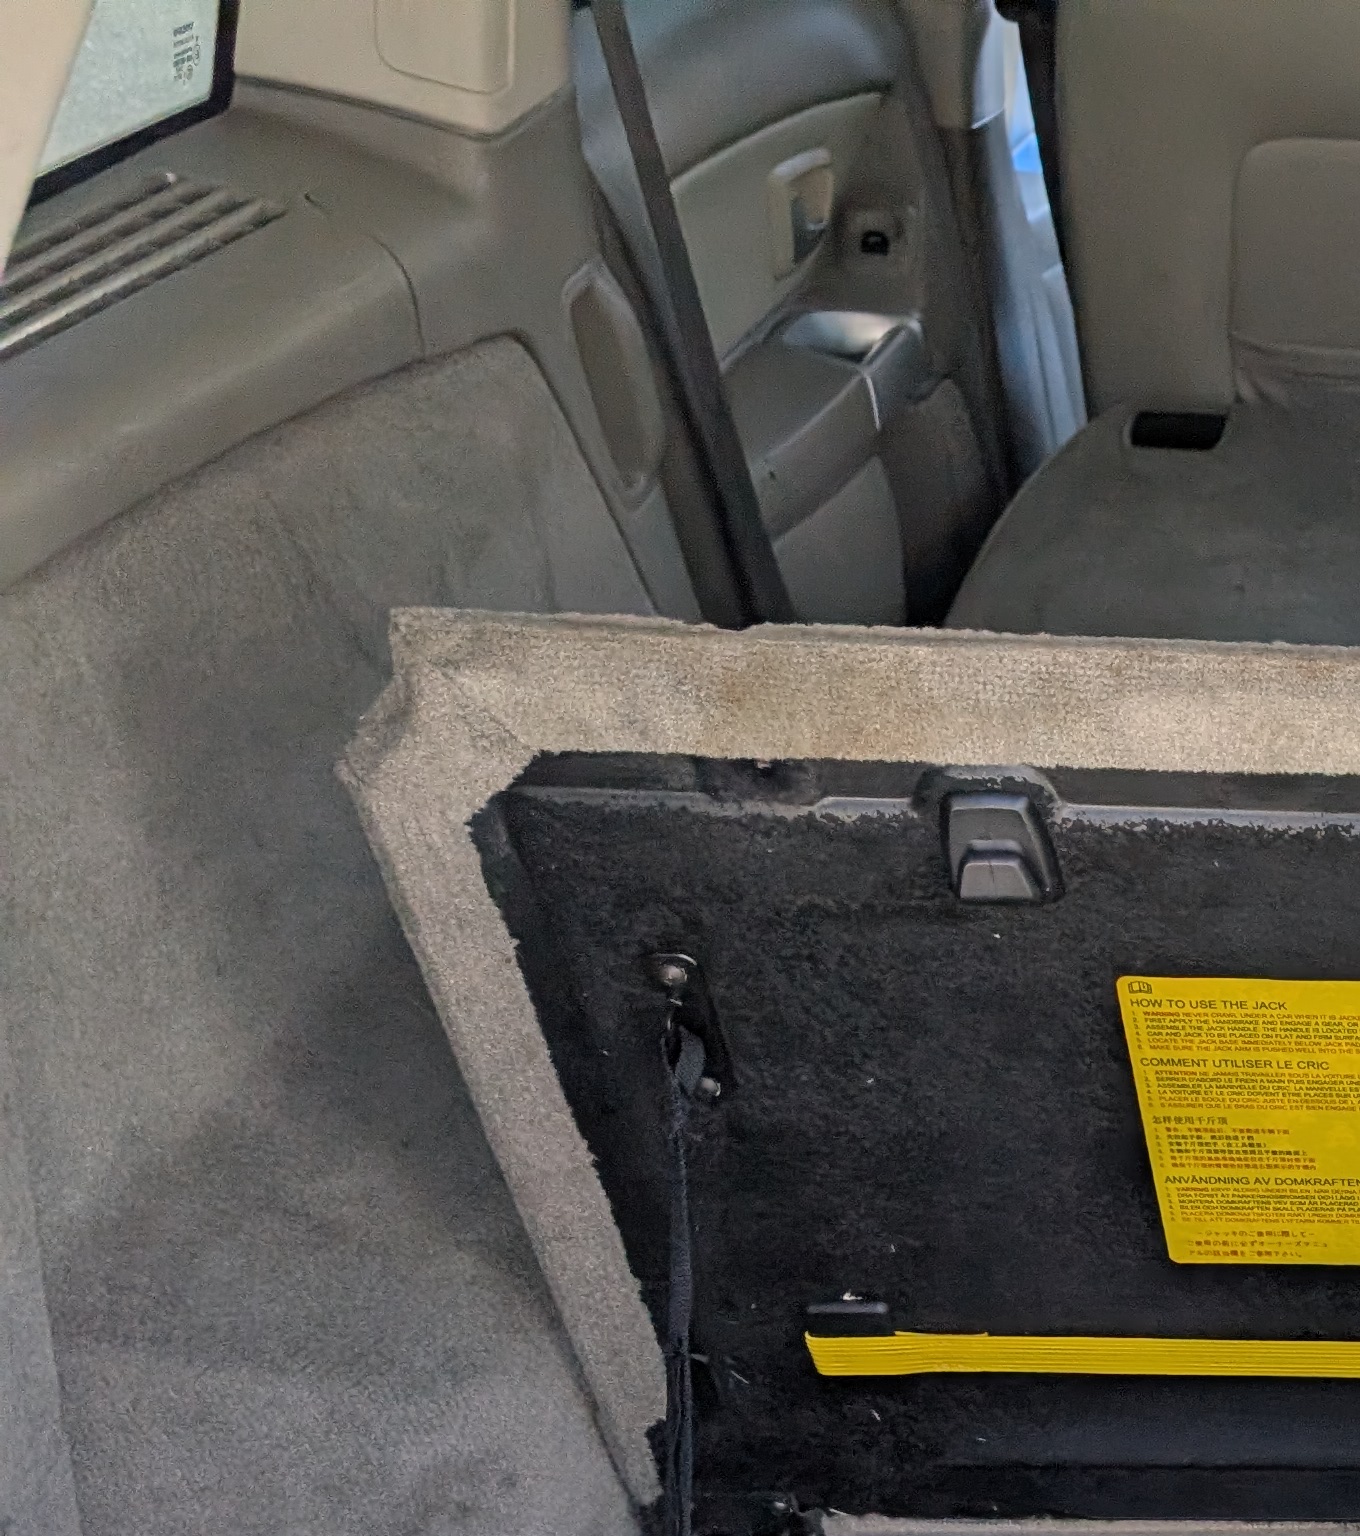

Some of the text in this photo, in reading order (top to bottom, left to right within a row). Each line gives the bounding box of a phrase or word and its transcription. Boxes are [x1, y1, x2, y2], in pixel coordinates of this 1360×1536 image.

[1130, 998, 1287, 1011] HOW TO USE THE JACK
[1140, 1058, 1329, 1070] COMMENT UTILISER LE CRIC
[1153, 1116, 1228, 1125] 怎样使用千斤顶
[1254, 1177, 1270, 1186] AV
